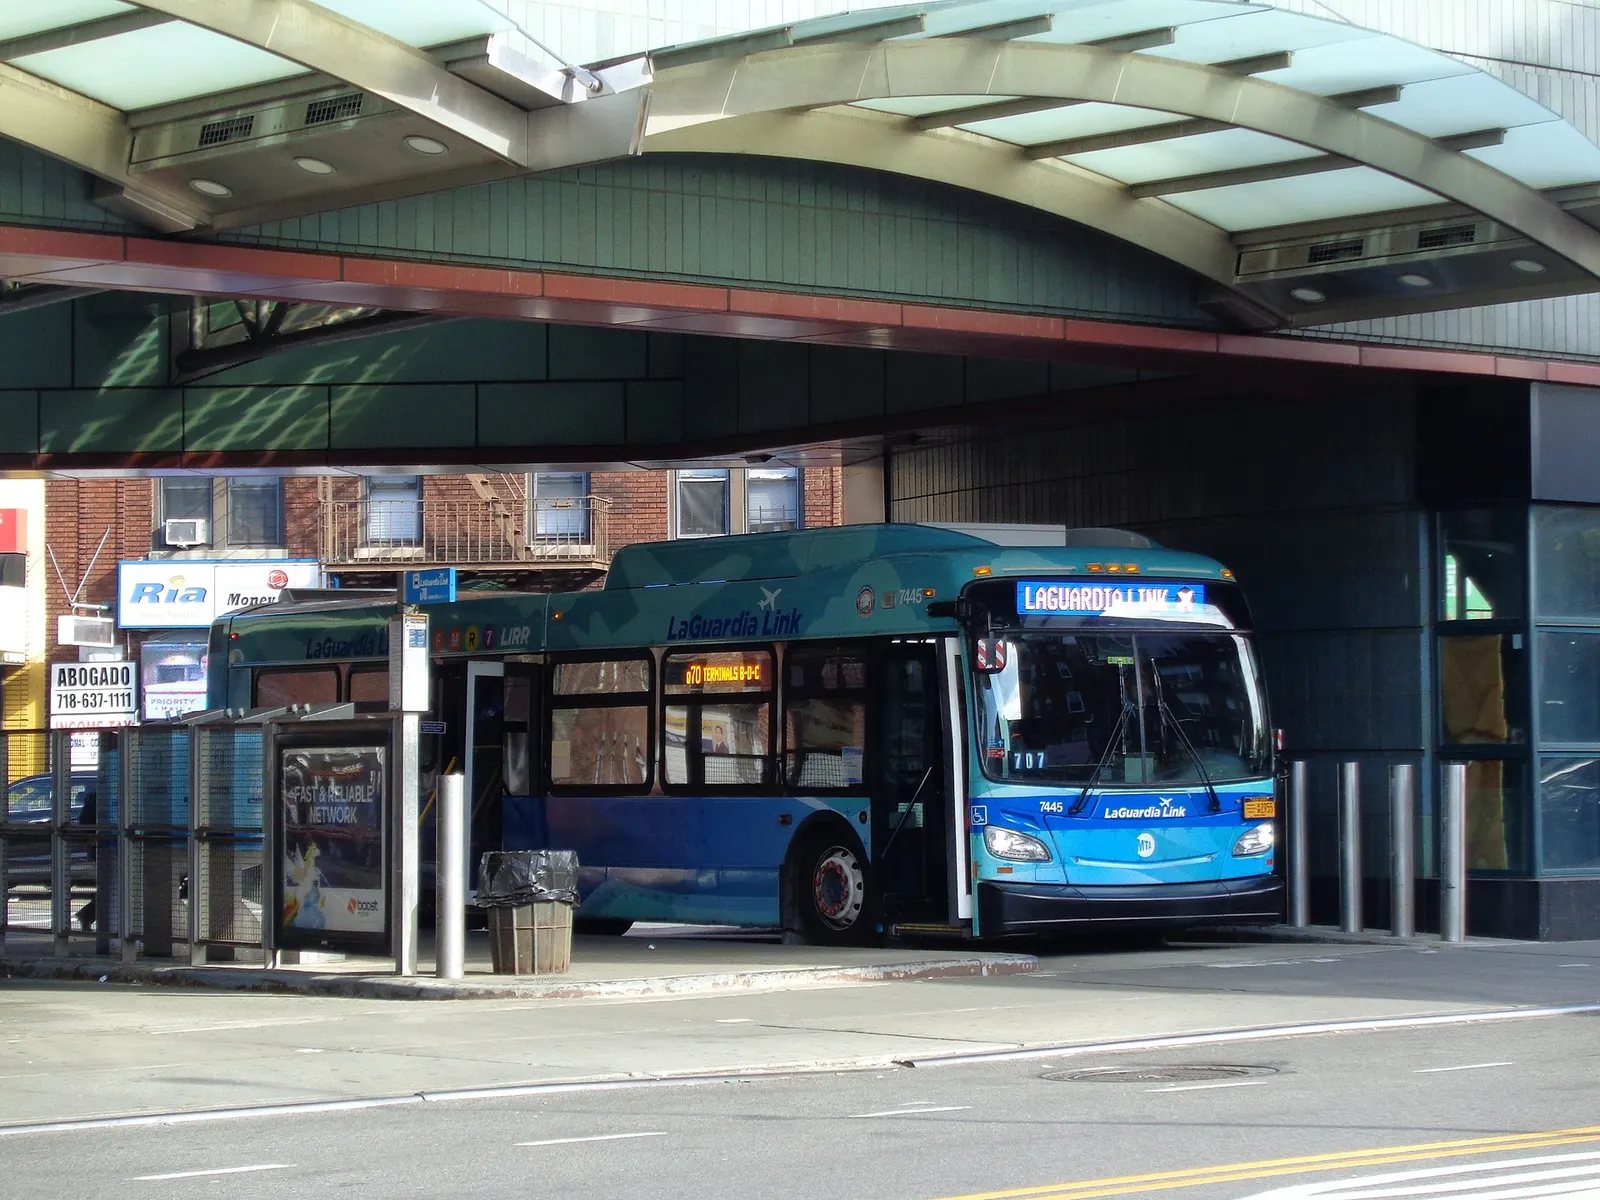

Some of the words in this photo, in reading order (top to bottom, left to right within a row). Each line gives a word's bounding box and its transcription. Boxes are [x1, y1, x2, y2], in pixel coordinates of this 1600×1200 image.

[129, 576, 207, 604] Ria
[899, 588, 922, 605] 7445
[1025, 586, 1122, 611] LAGUARDIA
[667, 609, 758, 640] LaGuardia
[762, 608, 804, 636] Link
[305, 632, 374, 659] LaGuardia
[469, 632, 476, 647] R
[486, 630, 493, 646] 7
[500, 626, 530, 647] LIRR
[57, 666, 130, 687] ABOGADO
[703, 666, 739, 682] TERMINALS
[56, 692, 132, 709] 718-637-1111
[295, 785, 316, 803] FAST
[328, 785, 373, 803] RELIABLE
[309, 806, 358, 824] NETWORK
[1039, 801, 1063, 813] 7445
[1104, 806, 1161, 819] LaGuardia
[1163, 805, 1186, 818] Link
[1137, 838, 1152, 852] MTA
[357, 899, 378, 912] boost
